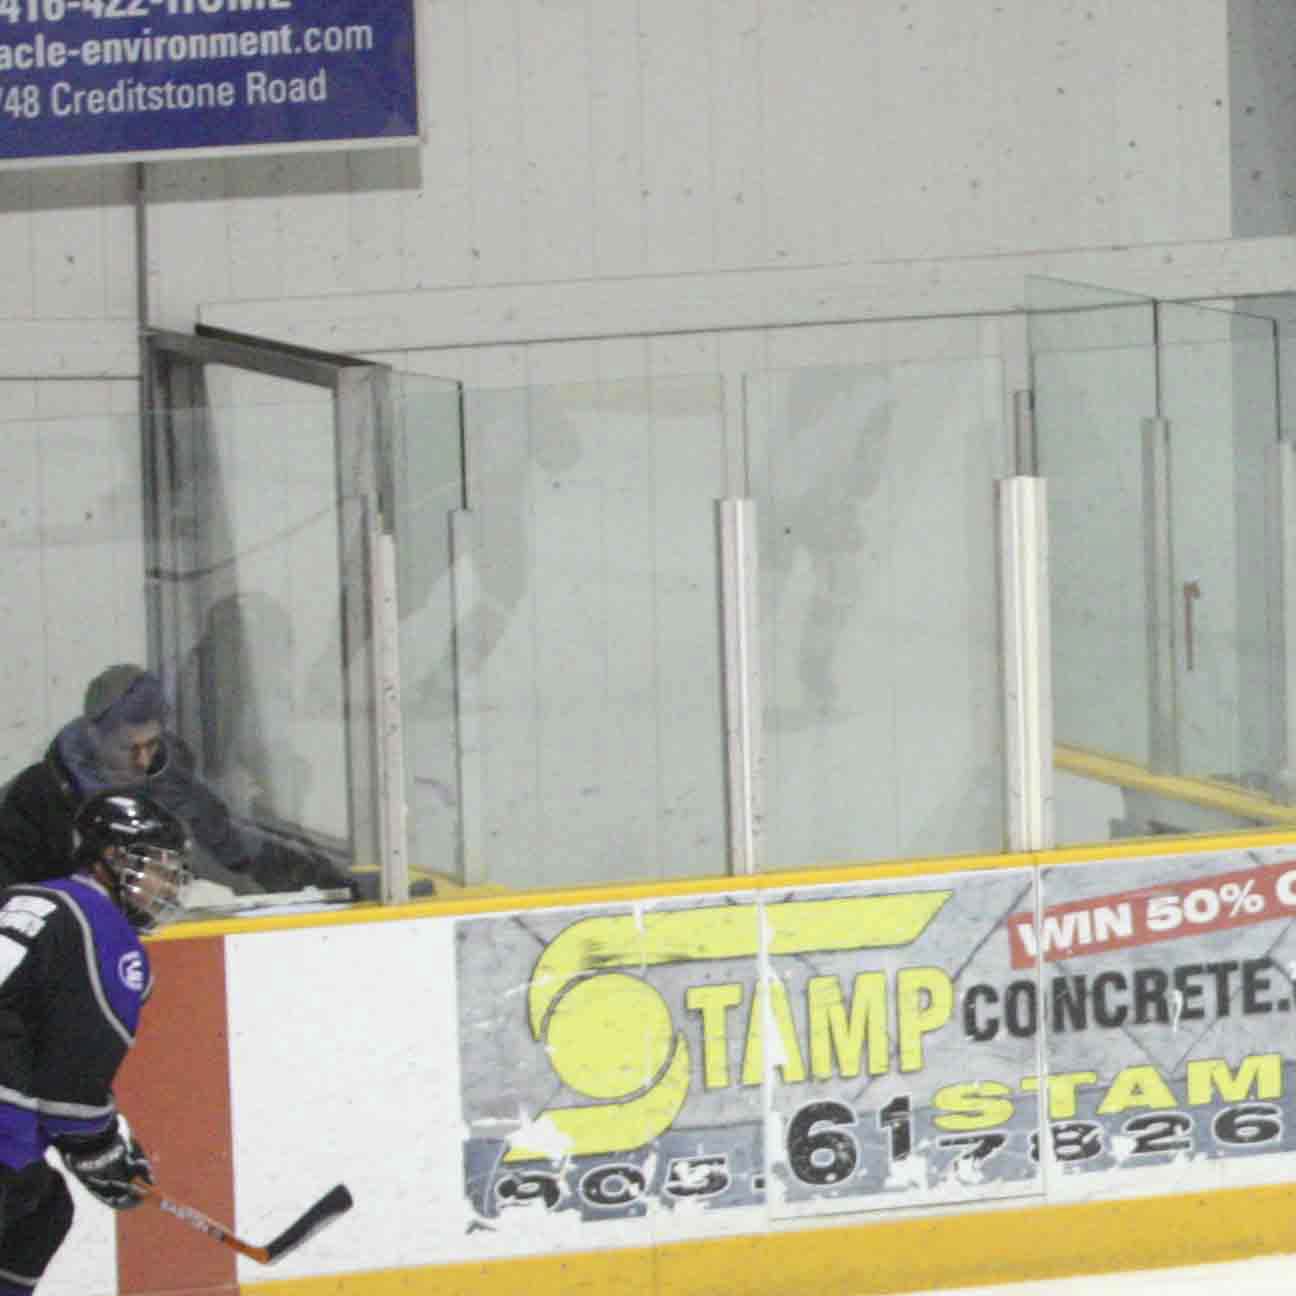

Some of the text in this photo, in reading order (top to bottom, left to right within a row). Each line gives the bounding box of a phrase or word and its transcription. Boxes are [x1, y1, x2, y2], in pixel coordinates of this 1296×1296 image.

[0, 69, 327, 119] 48 Creditstone Road
[1016, 903, 1134, 958] WIN
[1146, 879, 1264, 931] 50%
